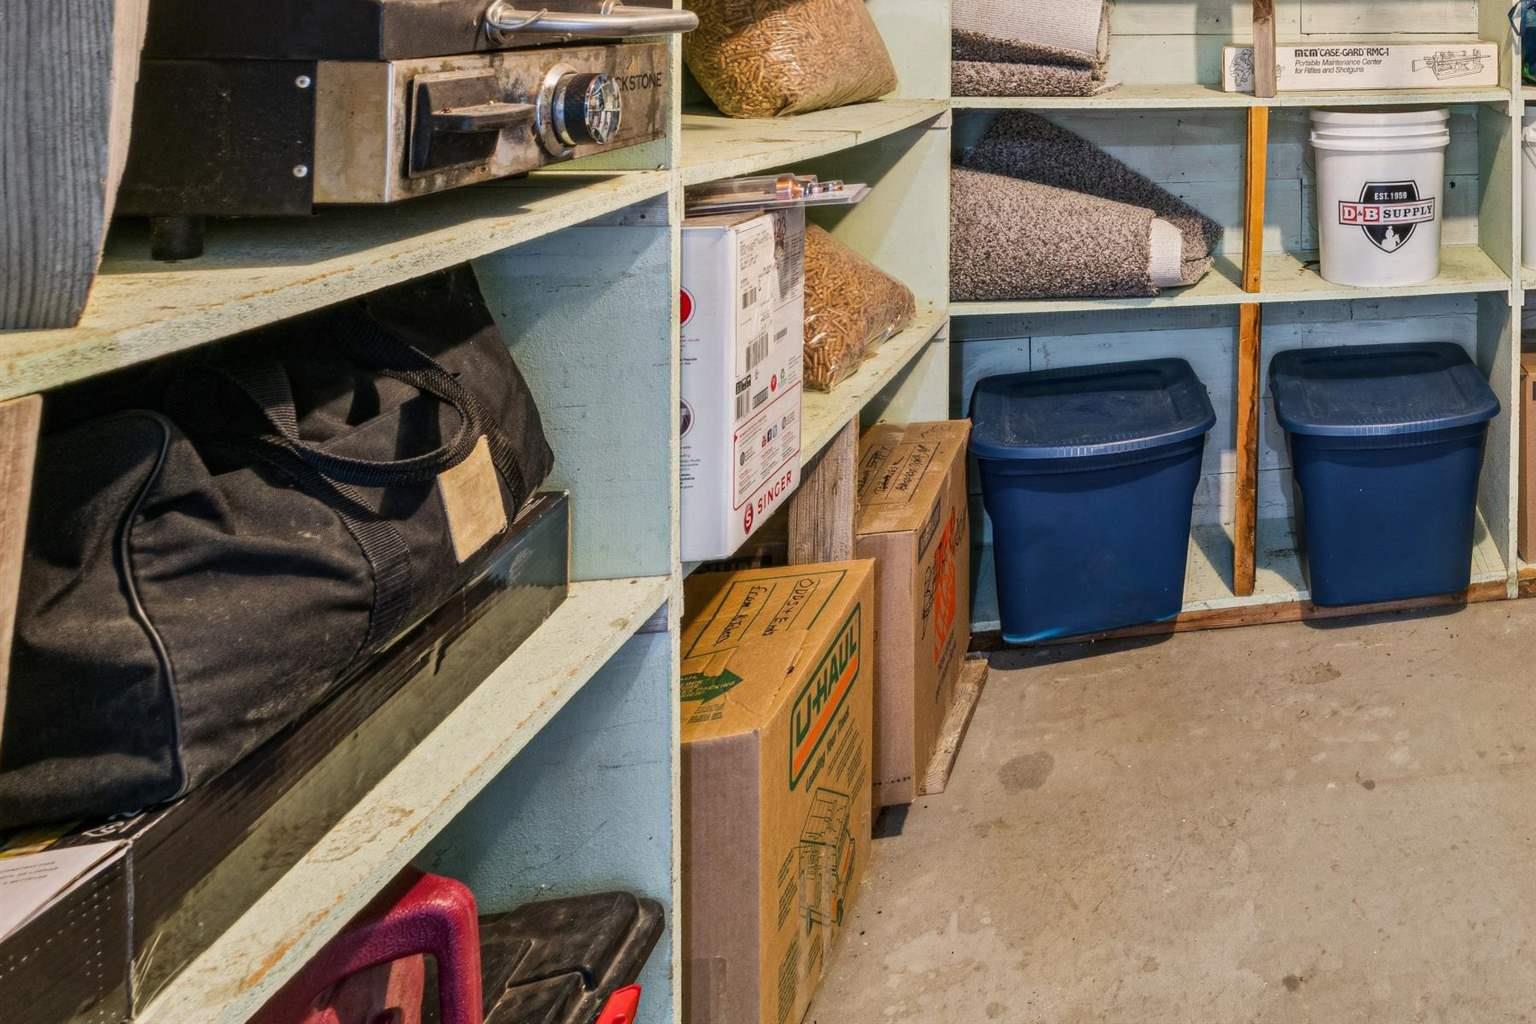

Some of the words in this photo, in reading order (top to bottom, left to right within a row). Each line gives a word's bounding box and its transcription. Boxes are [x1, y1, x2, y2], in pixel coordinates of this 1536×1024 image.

[1304, 66, 1321, 74] Rifles
[1335, 66, 1365, 75] Shotguns
[1375, 193, 1389, 201] EST.
[1383, 205, 1433, 219] SUPPLY
[757, 470, 792, 514] SINGER
[796, 624, 857, 748] U-HAUL
